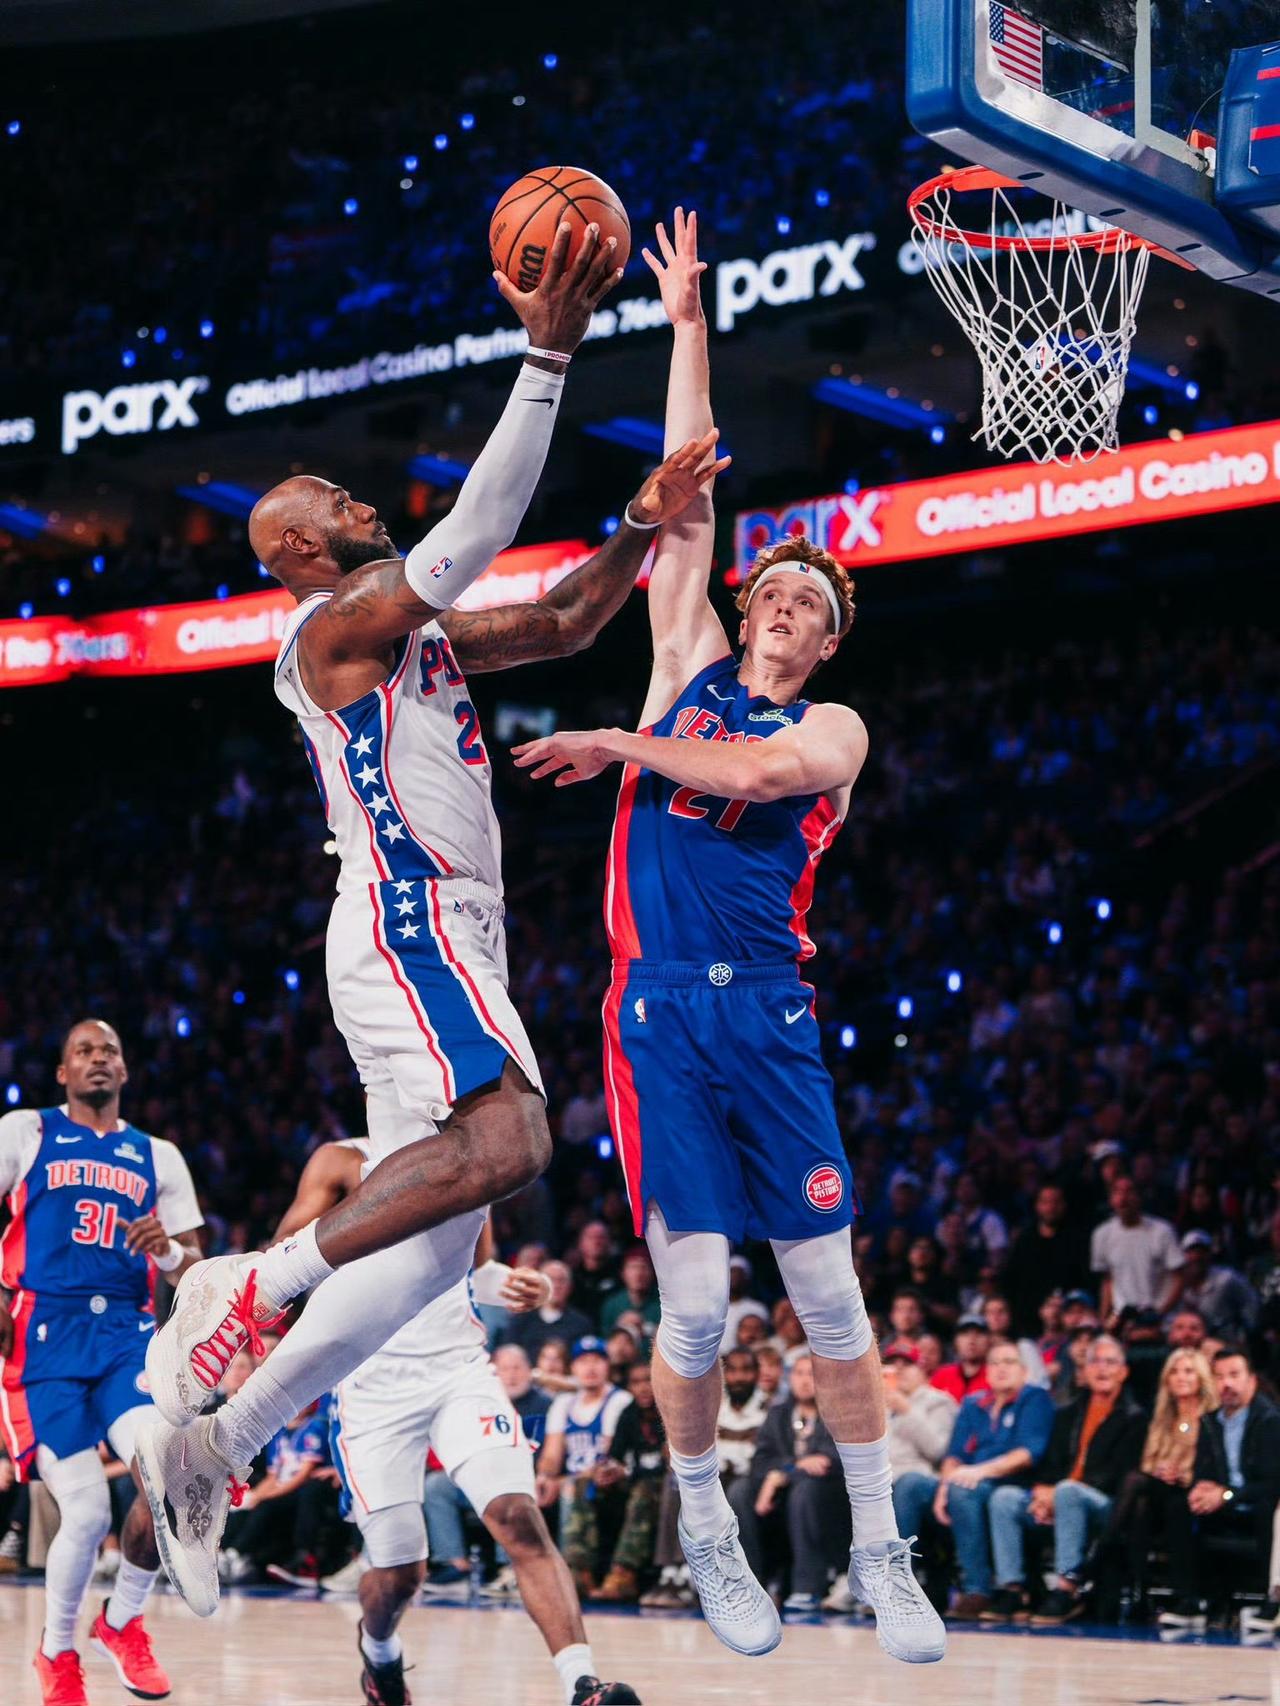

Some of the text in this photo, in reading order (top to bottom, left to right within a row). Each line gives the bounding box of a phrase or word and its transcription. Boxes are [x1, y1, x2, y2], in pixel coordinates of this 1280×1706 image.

[716, 236, 864, 332] parx
[226, 368, 307, 415] Official
[369, 342, 453, 384] Casino
[62, 379, 200, 454] parx
[915, 482, 1035, 536] Official
[1041, 467, 1134, 516] Local
[1139, 450, 1268, 500] Casino
[736, 491, 882, 582] parx
[45, 1159, 149, 1208] DETROIT
[812, 1176, 837, 1191] DETROIT
[813, 1184, 840, 1200] PISTONS
[71, 1199, 118, 1249] 31
[479, 1414, 511, 1437] 76
